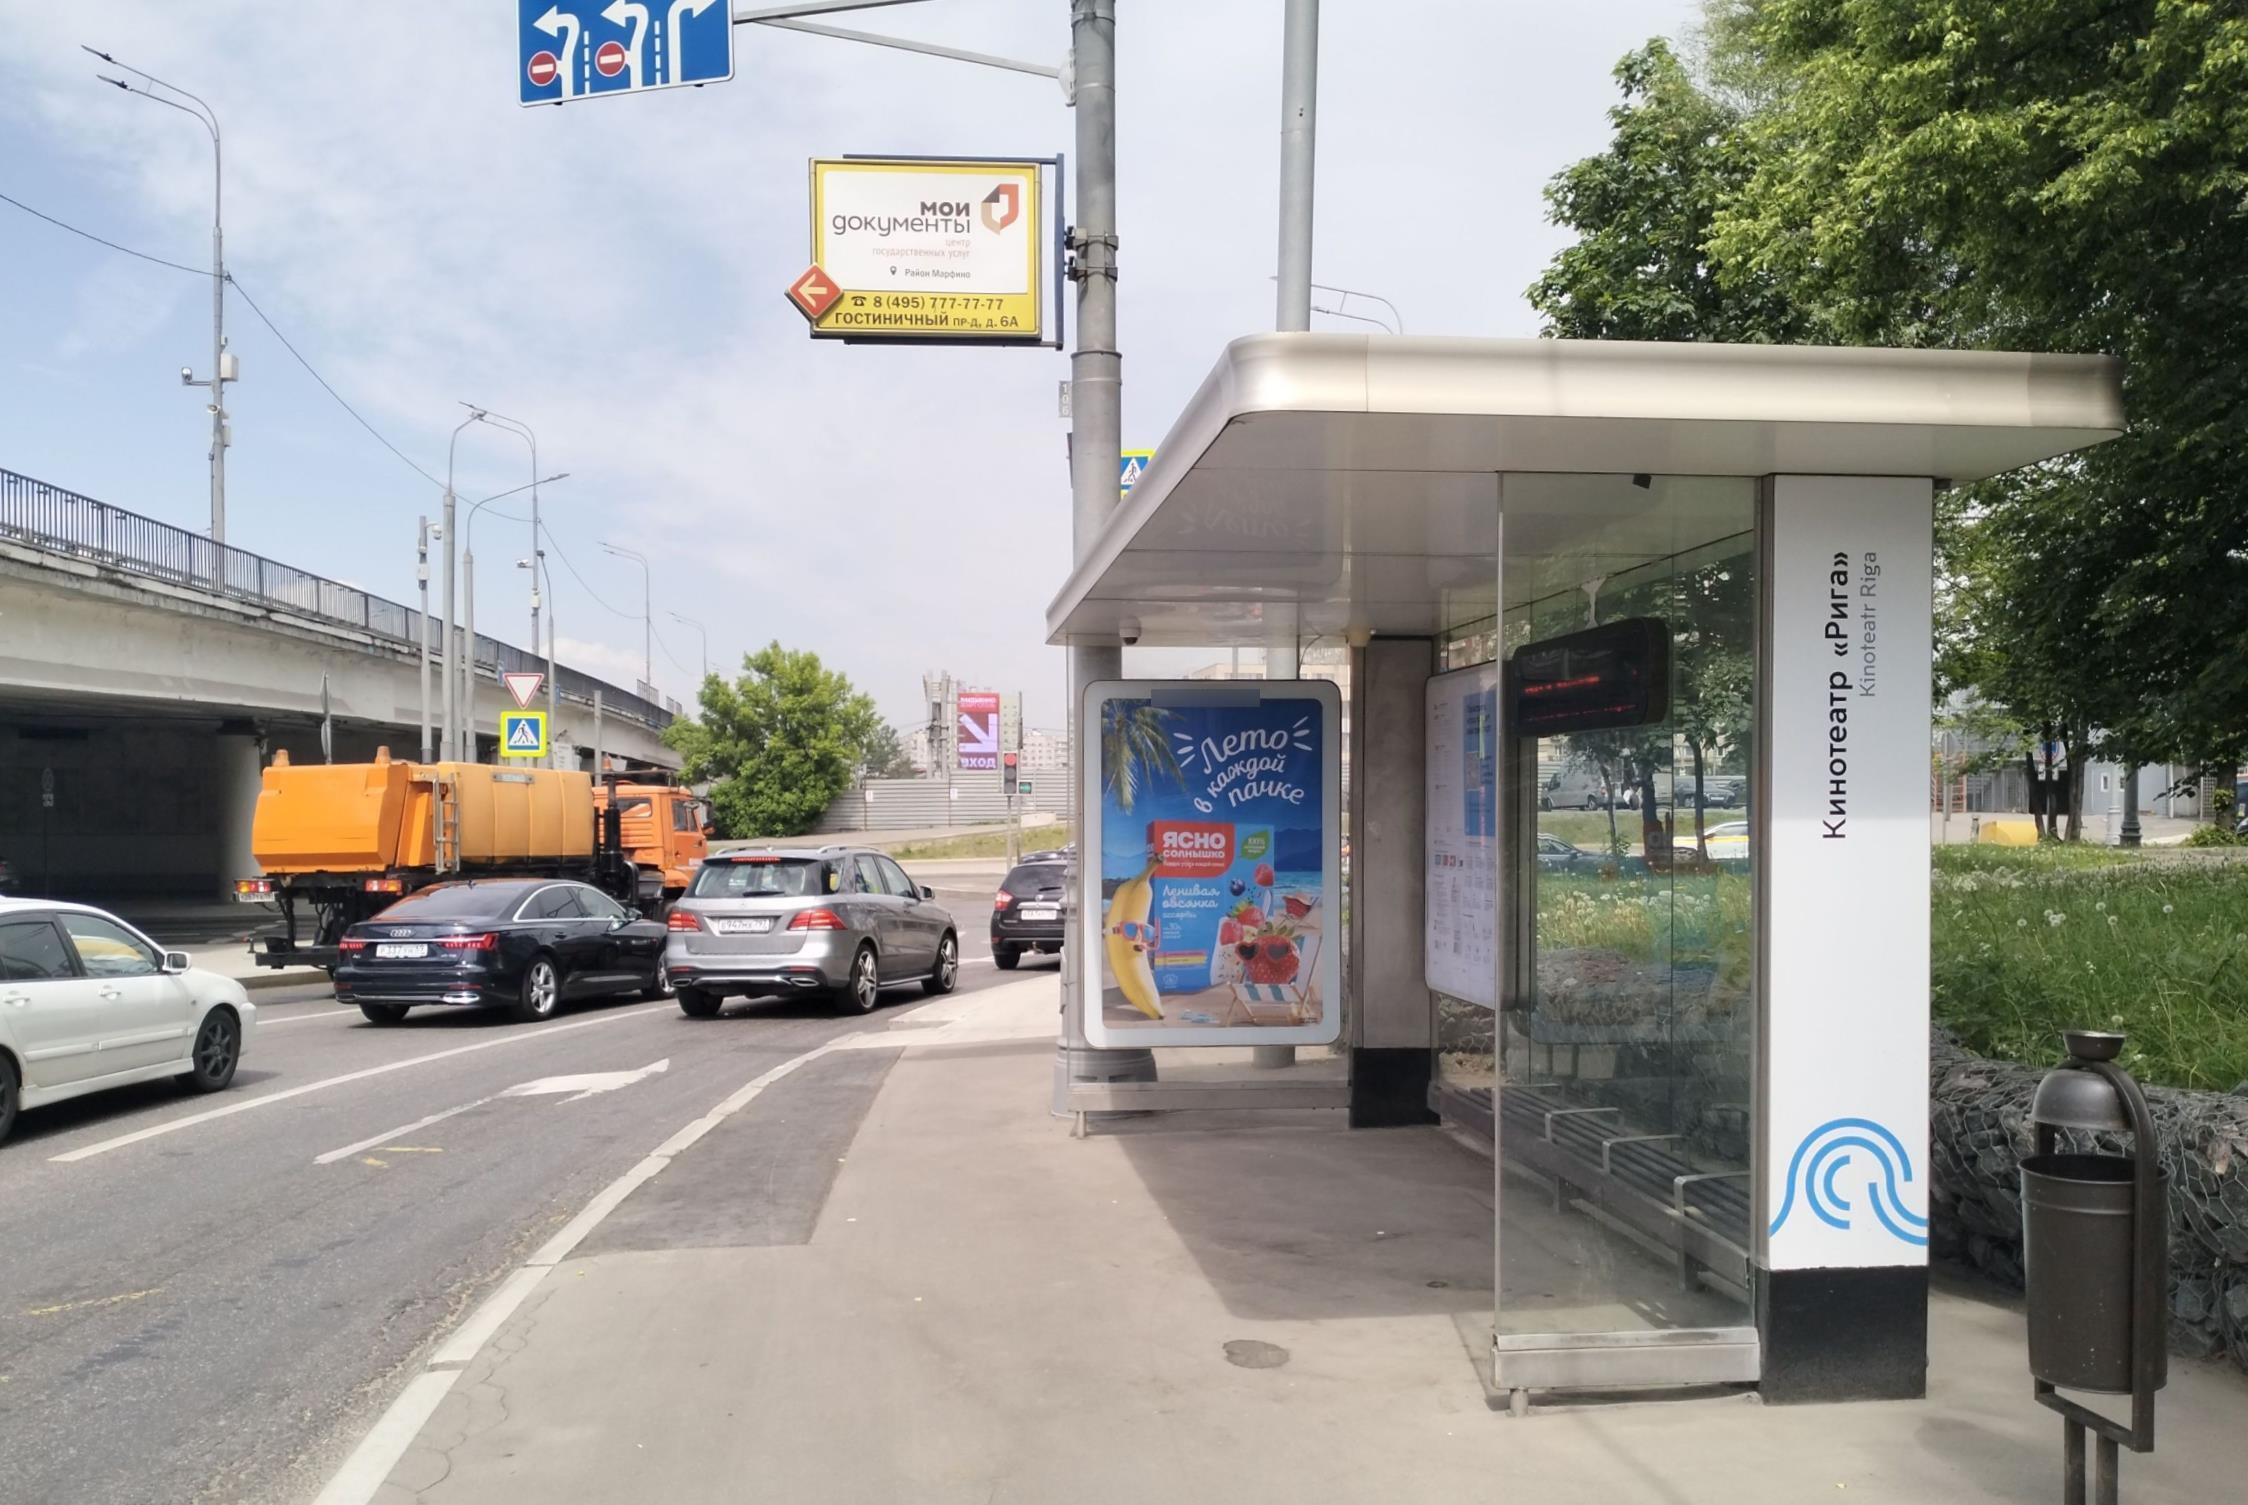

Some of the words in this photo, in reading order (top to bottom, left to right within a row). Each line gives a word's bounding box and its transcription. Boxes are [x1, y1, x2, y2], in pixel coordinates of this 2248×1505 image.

[920, 201, 970, 217] мои
[832, 215, 970, 237] документы
[872, 247, 945, 258] государственных
[948, 249, 970, 260] услуг
[945, 239, 970, 248] центр
[904, 268, 930, 277] Район
[932, 269, 971, 279] Марфино
[872, 296, 882, 308] 8
[886, 296, 925, 310] (495)
[929, 297, 1004, 310] 777-77-77
[834, 311, 949, 326] ГОСТИНИЧНЫЙ
[1000, 315, 1019, 327] 6А
[1860, 551, 1881, 597] Riga
[1824, 551, 1849, 657] «Рига»
[1859, 603, 1876, 697] Kinoteatr
[1200, 728, 1289, 775] Лето
[1822, 670, 1853, 839] Кинотеатр
[1193, 797, 1213, 813] в
[1206, 753, 1287, 798] каждой
[1228, 780, 1305, 808] пачке
[1162, 831, 1226, 849] ЯСНО
